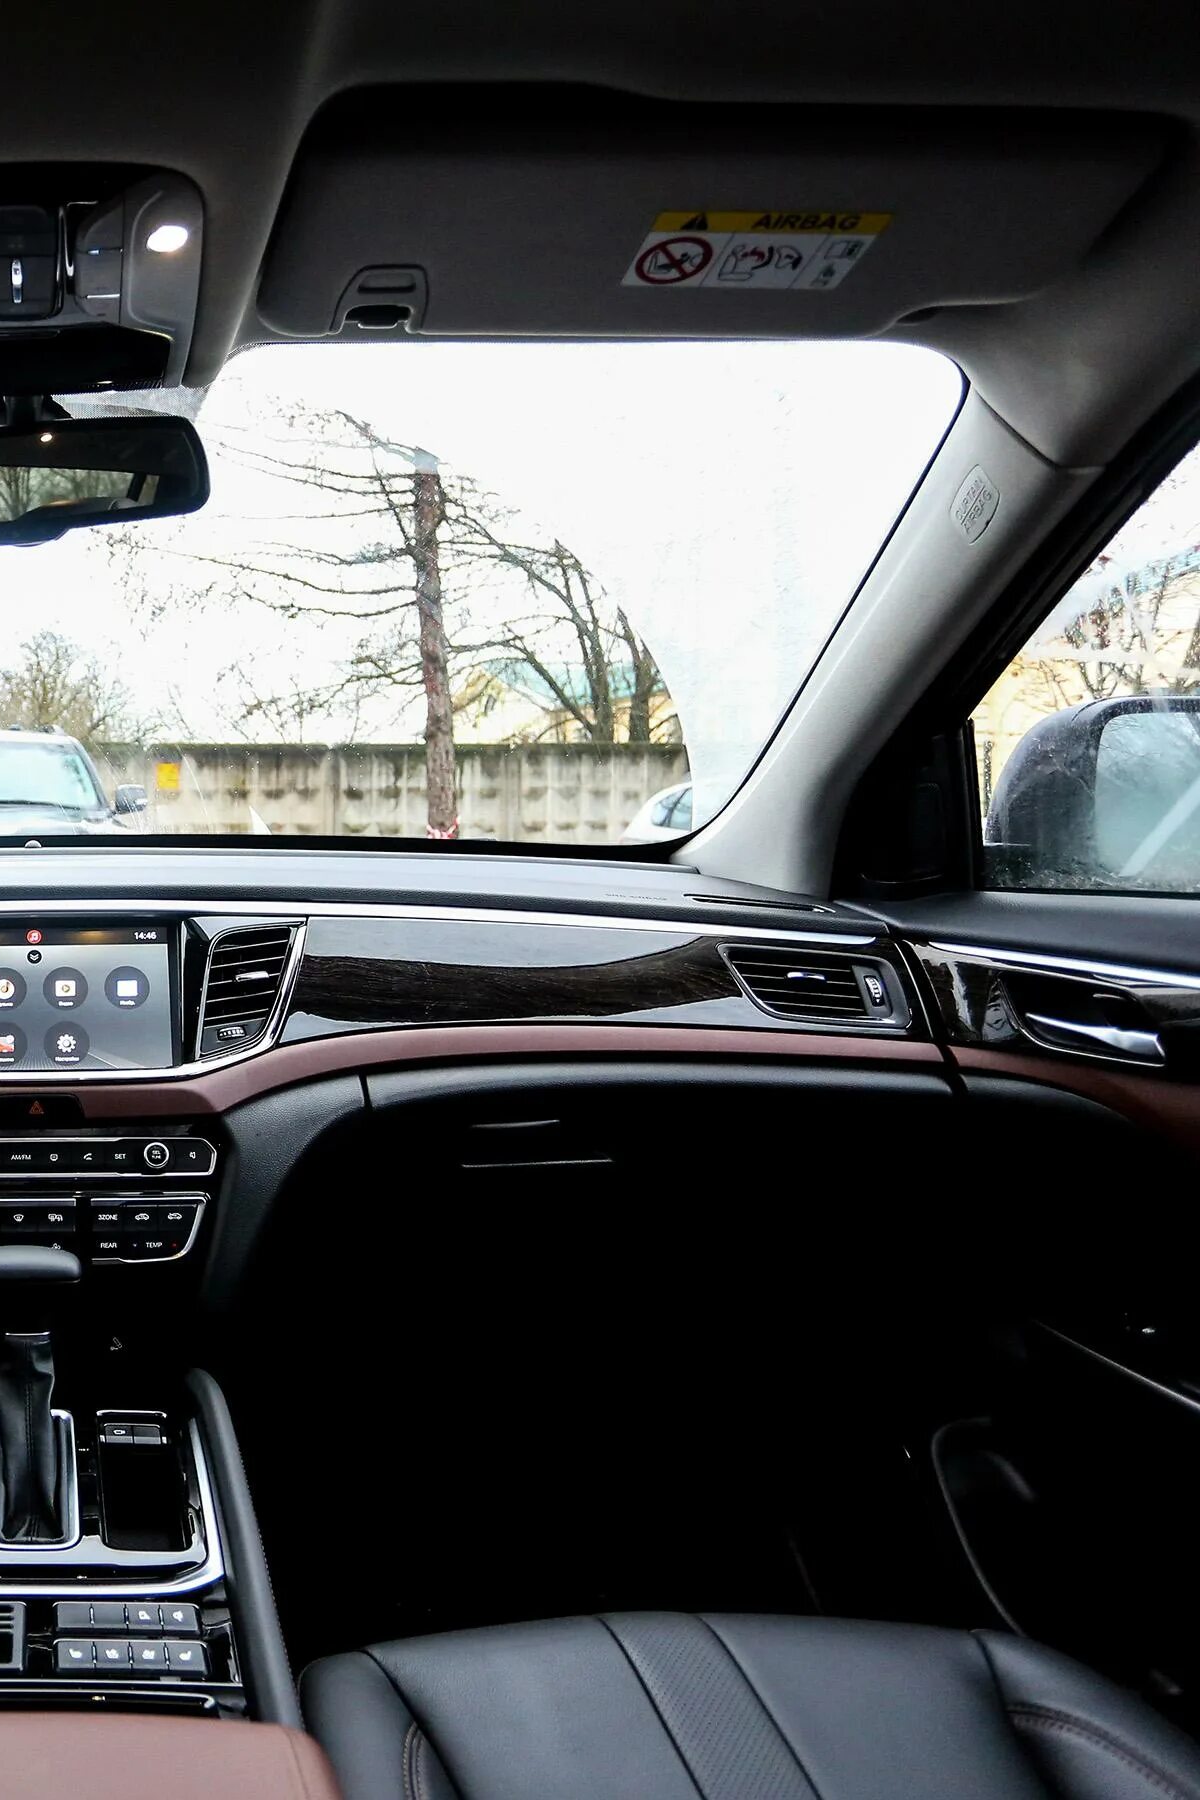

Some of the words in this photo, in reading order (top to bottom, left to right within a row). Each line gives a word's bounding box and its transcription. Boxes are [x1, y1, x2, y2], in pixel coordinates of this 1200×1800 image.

[752, 213, 862, 230] AIRBAG
[955, 476, 984, 520] CURTAIN
[964, 489, 992, 534] AIRBAG
[134, 931, 157, 940] 14:46
